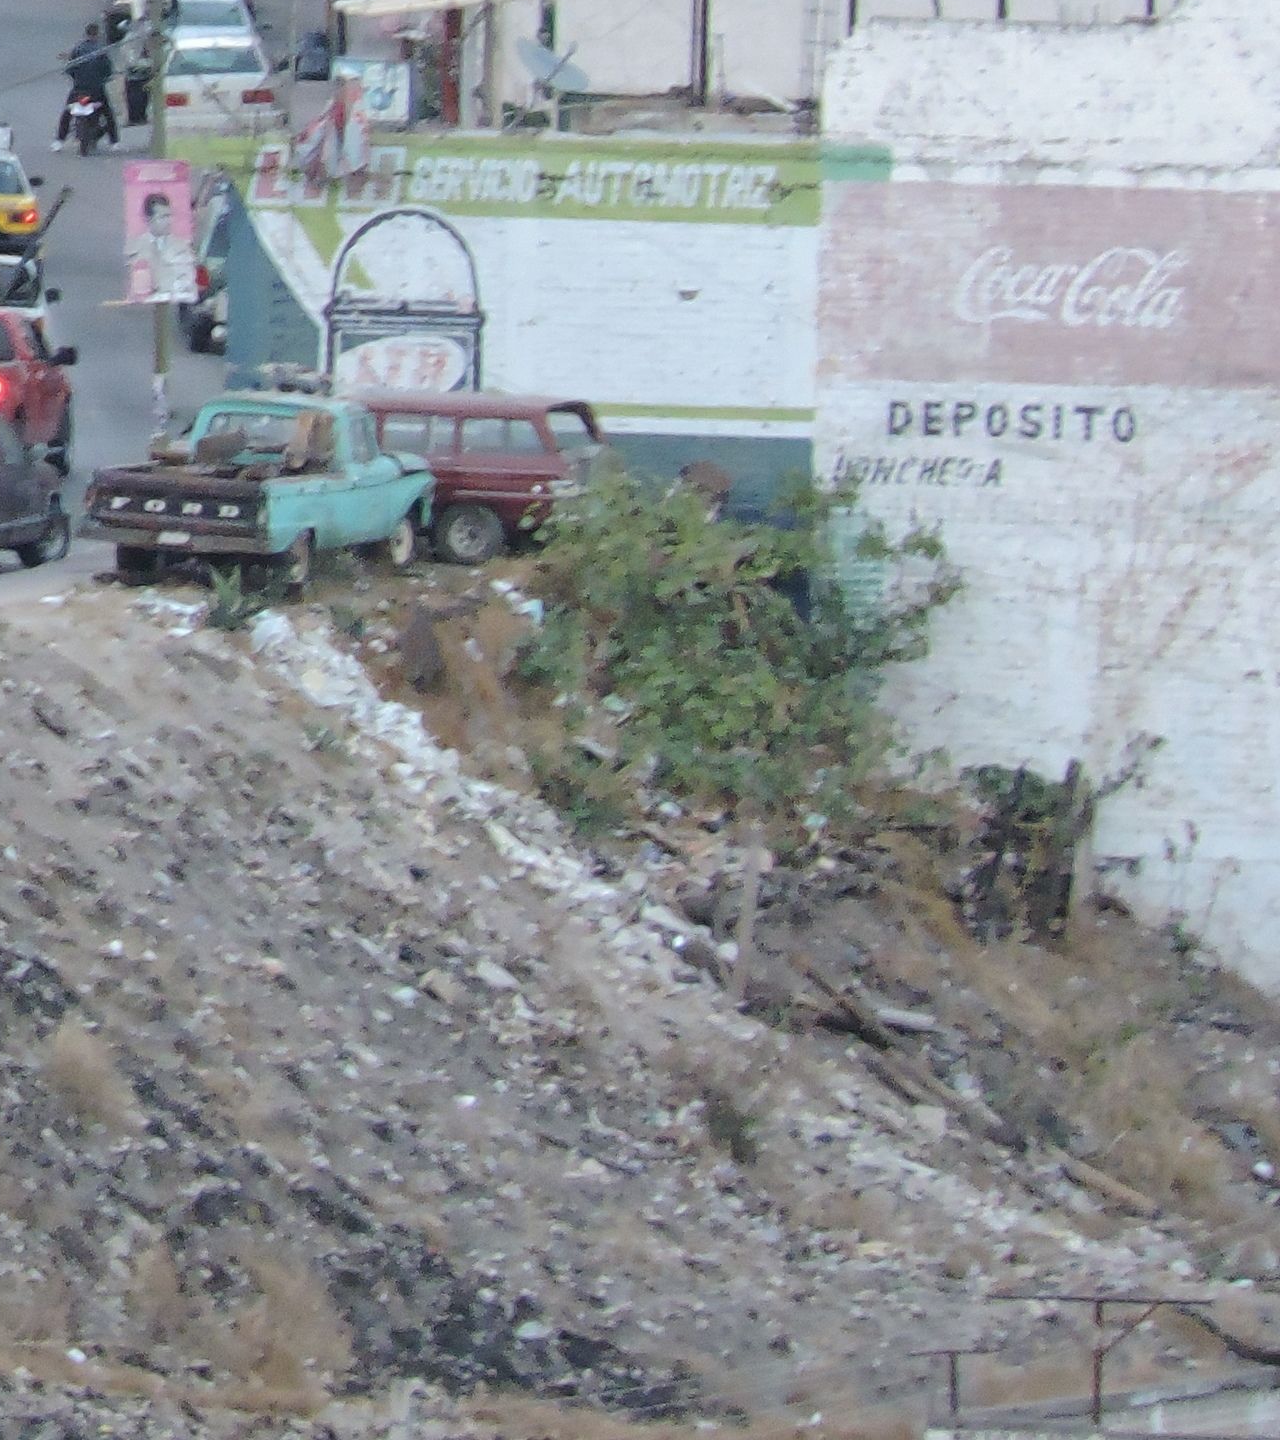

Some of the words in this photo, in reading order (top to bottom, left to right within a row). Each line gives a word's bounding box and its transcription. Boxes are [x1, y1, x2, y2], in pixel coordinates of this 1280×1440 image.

[409, 157, 539, 203] SERVICIO
[552, 160, 778, 210] AUTOMOTRIZ
[885, 400, 1137, 445] DEPOSITO
[109, 495, 242, 520] FORD
